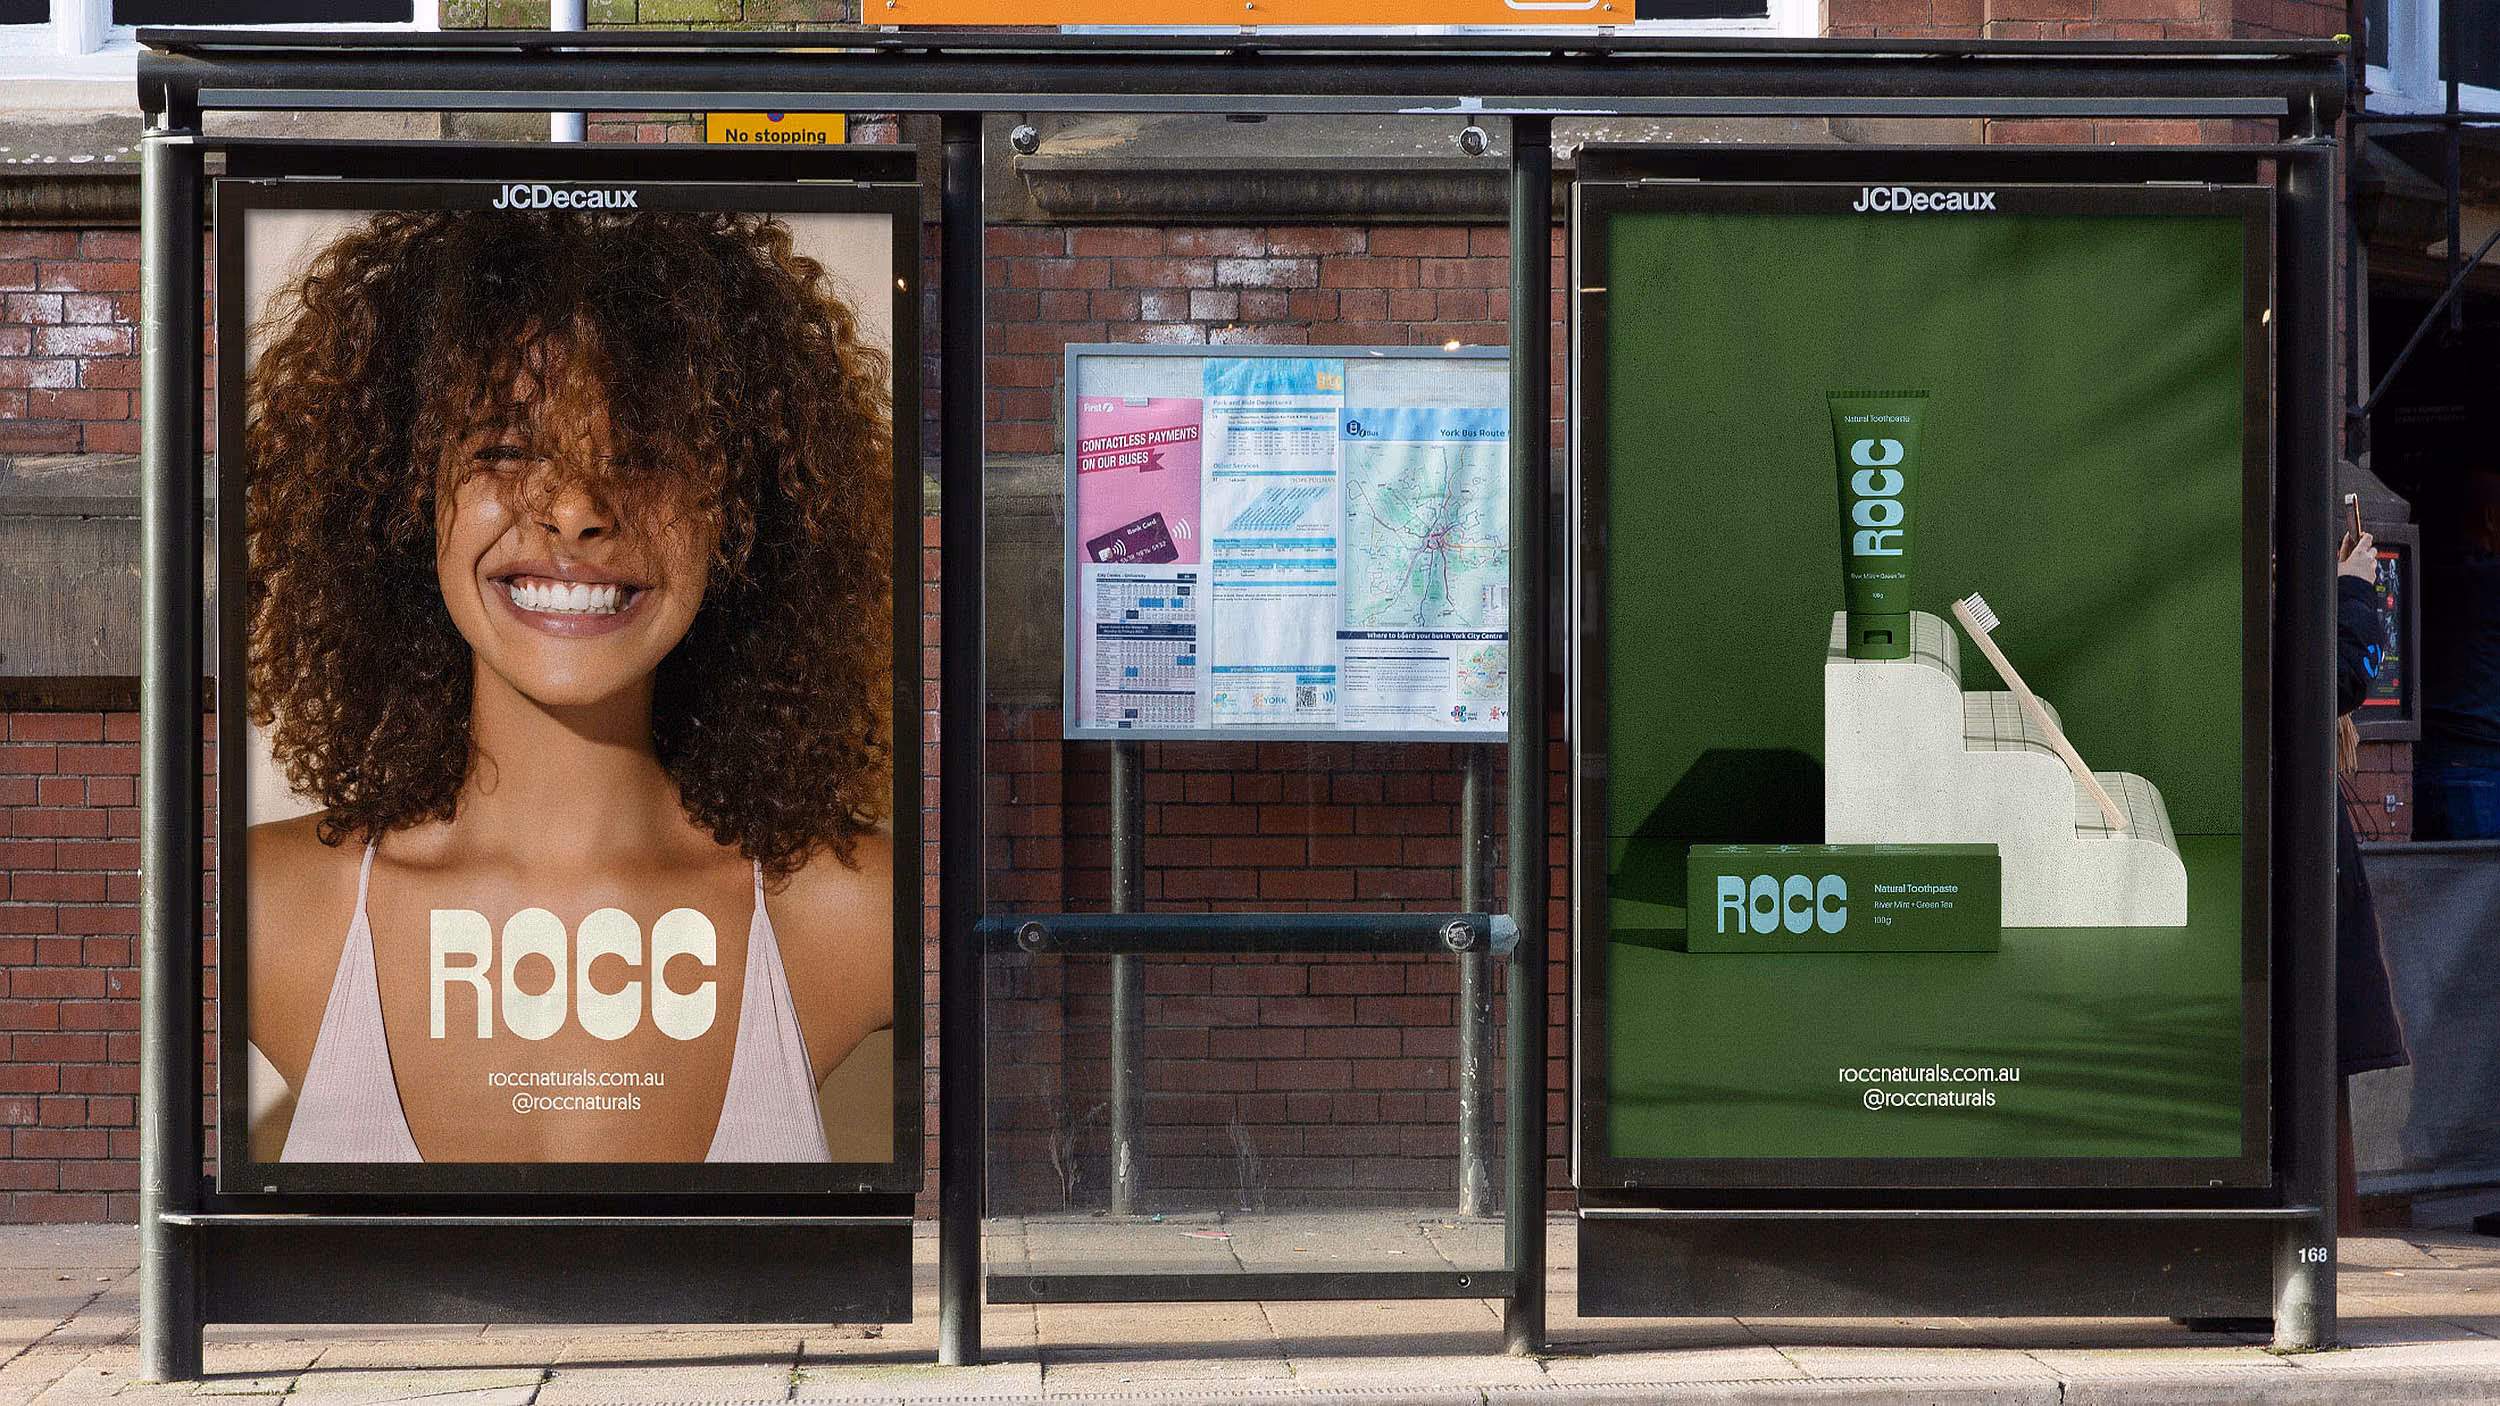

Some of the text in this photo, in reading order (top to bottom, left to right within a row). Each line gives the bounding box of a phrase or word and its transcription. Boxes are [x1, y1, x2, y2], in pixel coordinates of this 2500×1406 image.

[725, 127, 827, 144] No stopping
[493, 184, 638, 209] JCDecaux
[1853, 187, 1996, 212] JCDecaux
[1083, 403, 1101, 412] First
[1082, 427, 1197, 452] CONTACTLESS PAYMENTS
[1440, 429, 1460, 437] York
[1462, 429, 1477, 437] Bus
[1479, 429, 1505, 437] Route
[1082, 451, 1149, 471] ON OUR BUSES
[1851, 438, 1905, 556] ROCC
[1126, 518, 1157, 535] Bank Card
[1416, 633, 1431, 641] your
[1467, 633, 1480, 641] City
[1264, 696, 1287, 705] YORK
[1874, 884, 1959, 895] Natural Toothpaste
[1717, 874, 1848, 934] ROCC
[1940, 900, 1953, 909] Tea
[430, 907, 717, 1041] ROCC
[488, 1068, 665, 1087] roccnaturals.com.au
[1838, 1064, 2020, 1083] roccnaturals.com.au
[511, 1092, 642, 1114] @roccnaturals
[1863, 1087, 1996, 1111] @roccnaturals
[2298, 1247, 2328, 1263] 168
